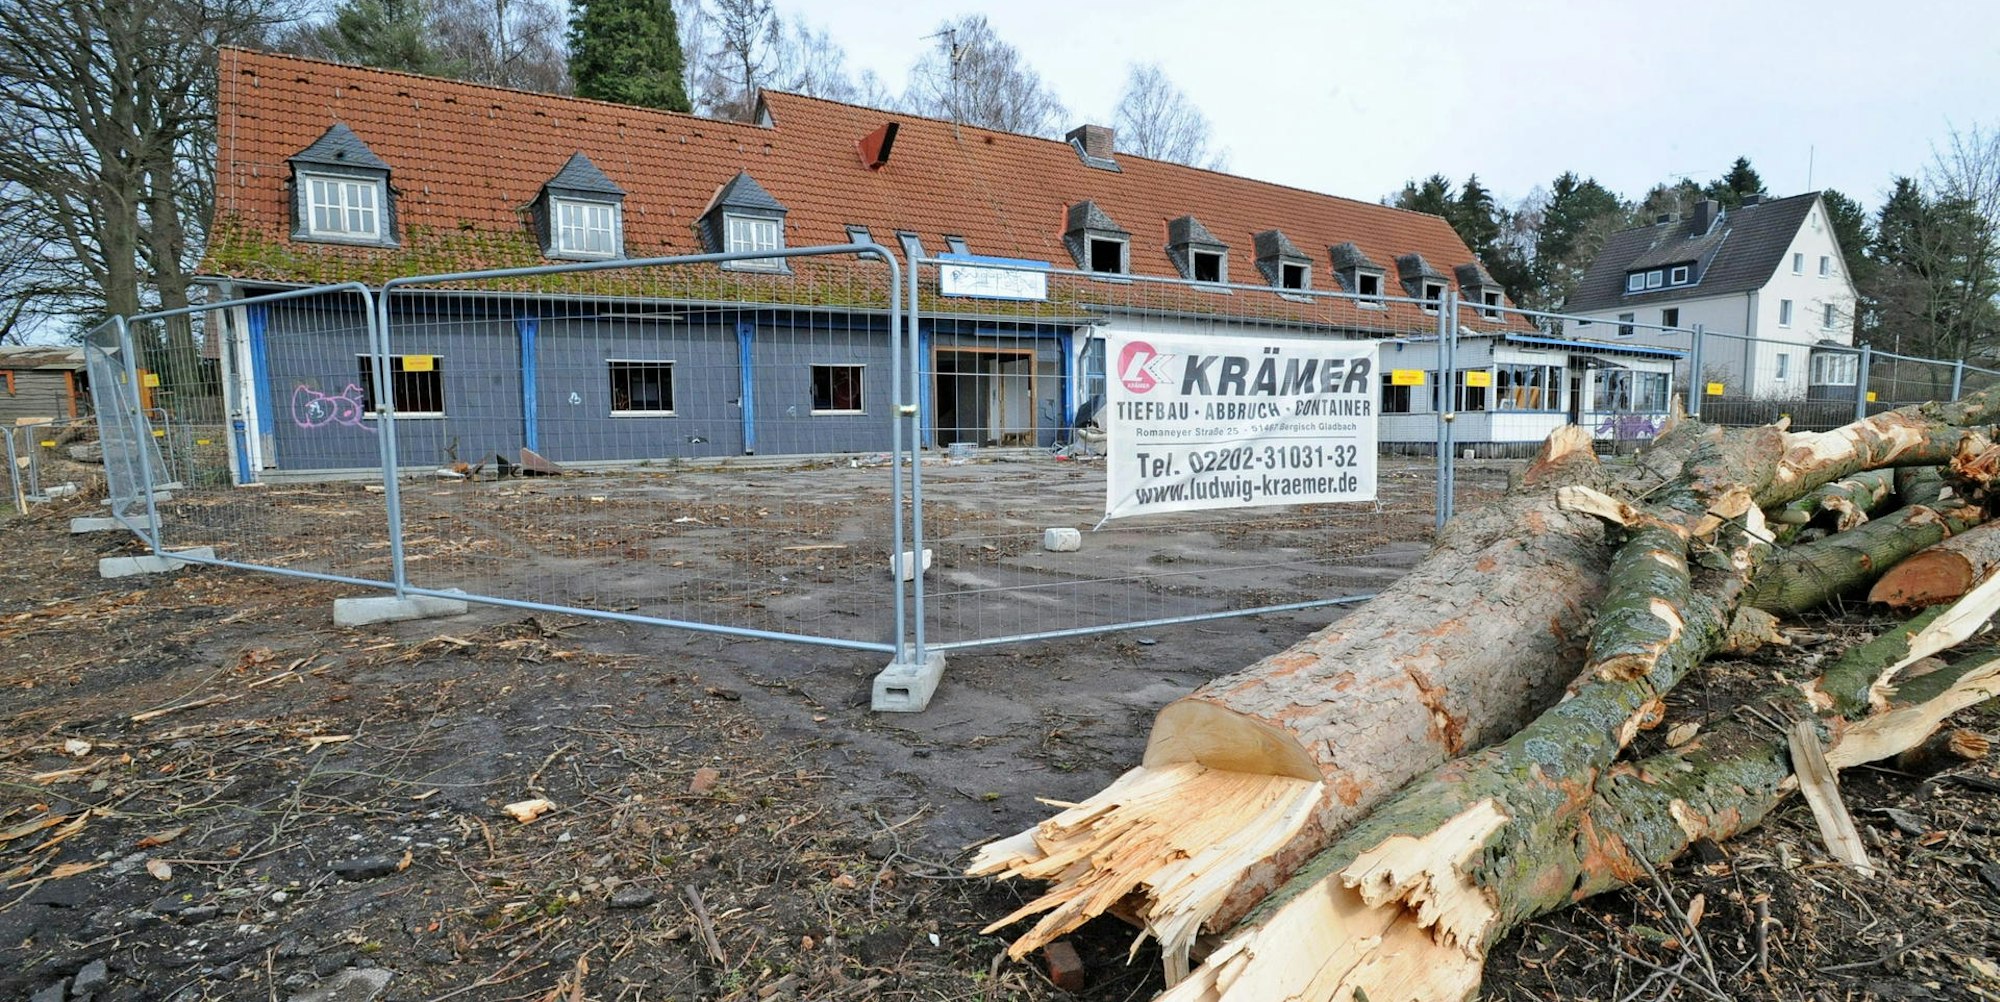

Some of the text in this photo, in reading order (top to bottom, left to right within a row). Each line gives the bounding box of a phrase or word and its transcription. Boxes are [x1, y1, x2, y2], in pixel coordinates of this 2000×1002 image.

[1180, 346, 1372, 396] KRÄMER
[1117, 399, 1371, 420] TIEFBAU ABBRUCH CONTAINER
[1136, 427, 1192, 438] Romaneyer
[1195, 427, 1224, 437] Straße
[1227, 427, 1240, 435] 25
[1279, 422, 1316, 432] Bergisch
[1318, 422, 1357, 431] Gladbach
[1137, 444, 1358, 478] Tel. 02202-31031-32
[1136, 471, 1358, 504] www.ludwig-kraemer.de
